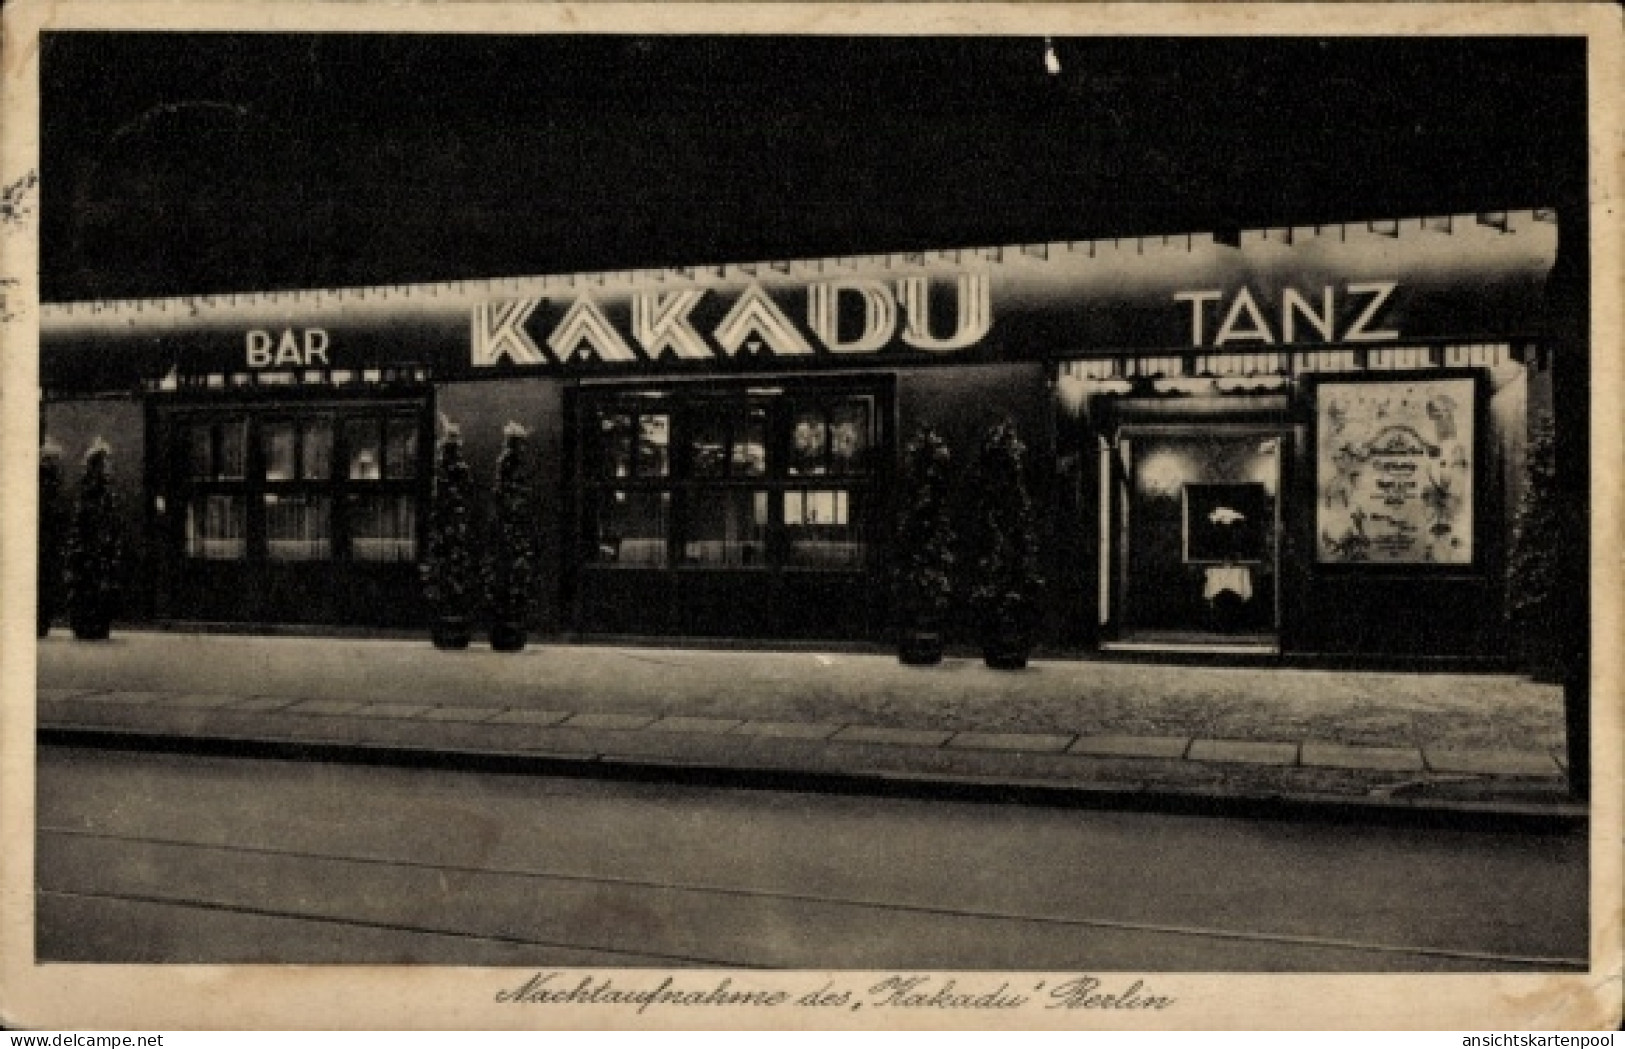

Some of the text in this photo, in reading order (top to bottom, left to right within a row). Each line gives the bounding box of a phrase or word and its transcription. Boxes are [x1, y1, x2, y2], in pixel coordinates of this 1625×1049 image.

[470, 272, 991, 366] KAKADU
[1173, 281, 1400, 347] TANZ
[246, 328, 329, 367] BAR
